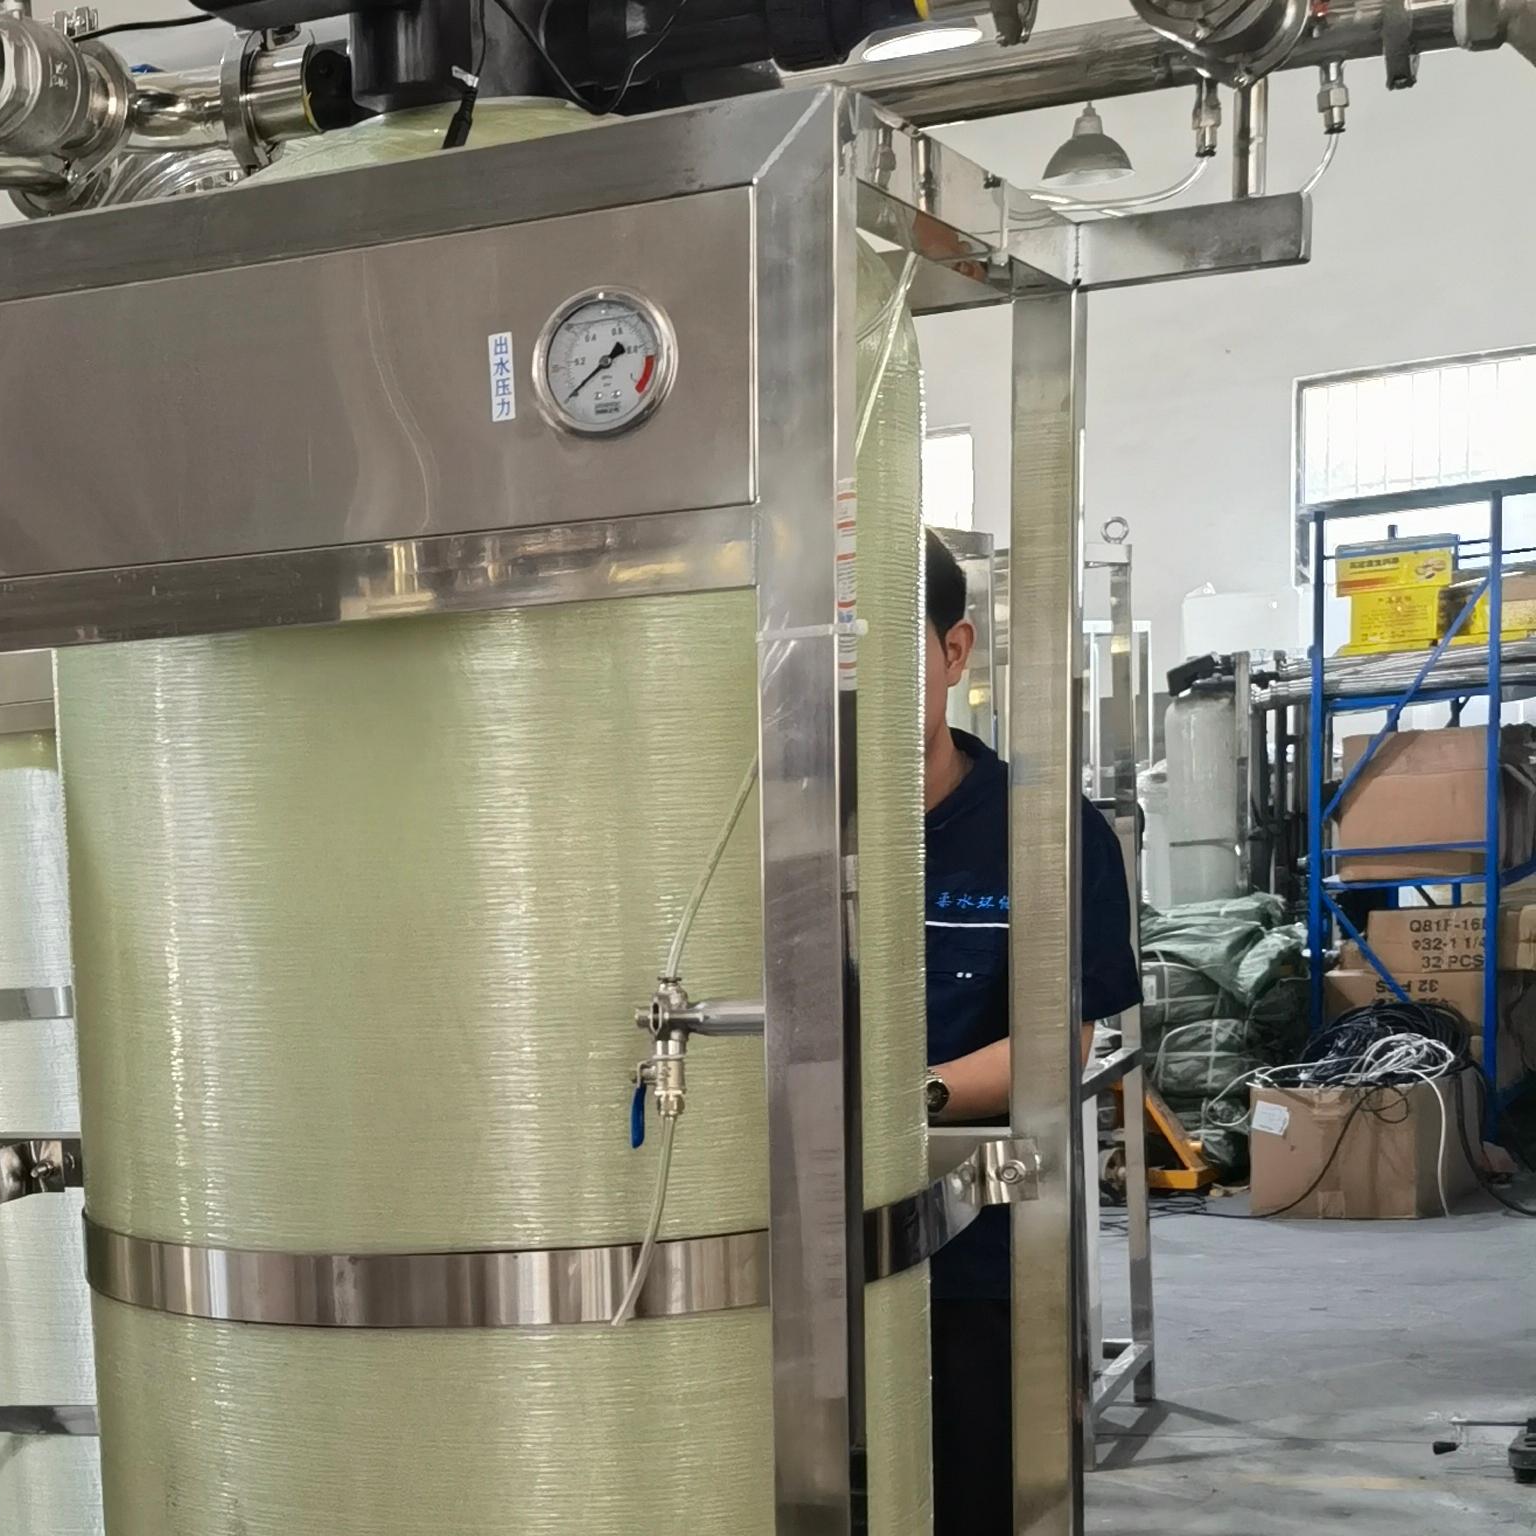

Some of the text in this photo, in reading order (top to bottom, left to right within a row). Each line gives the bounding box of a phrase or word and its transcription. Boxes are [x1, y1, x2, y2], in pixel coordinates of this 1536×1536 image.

[493, 336, 512, 418] 出水压力
[1422, 955, 1484, 968] 32 PCS
[1376, 980, 1412, 993] PS
